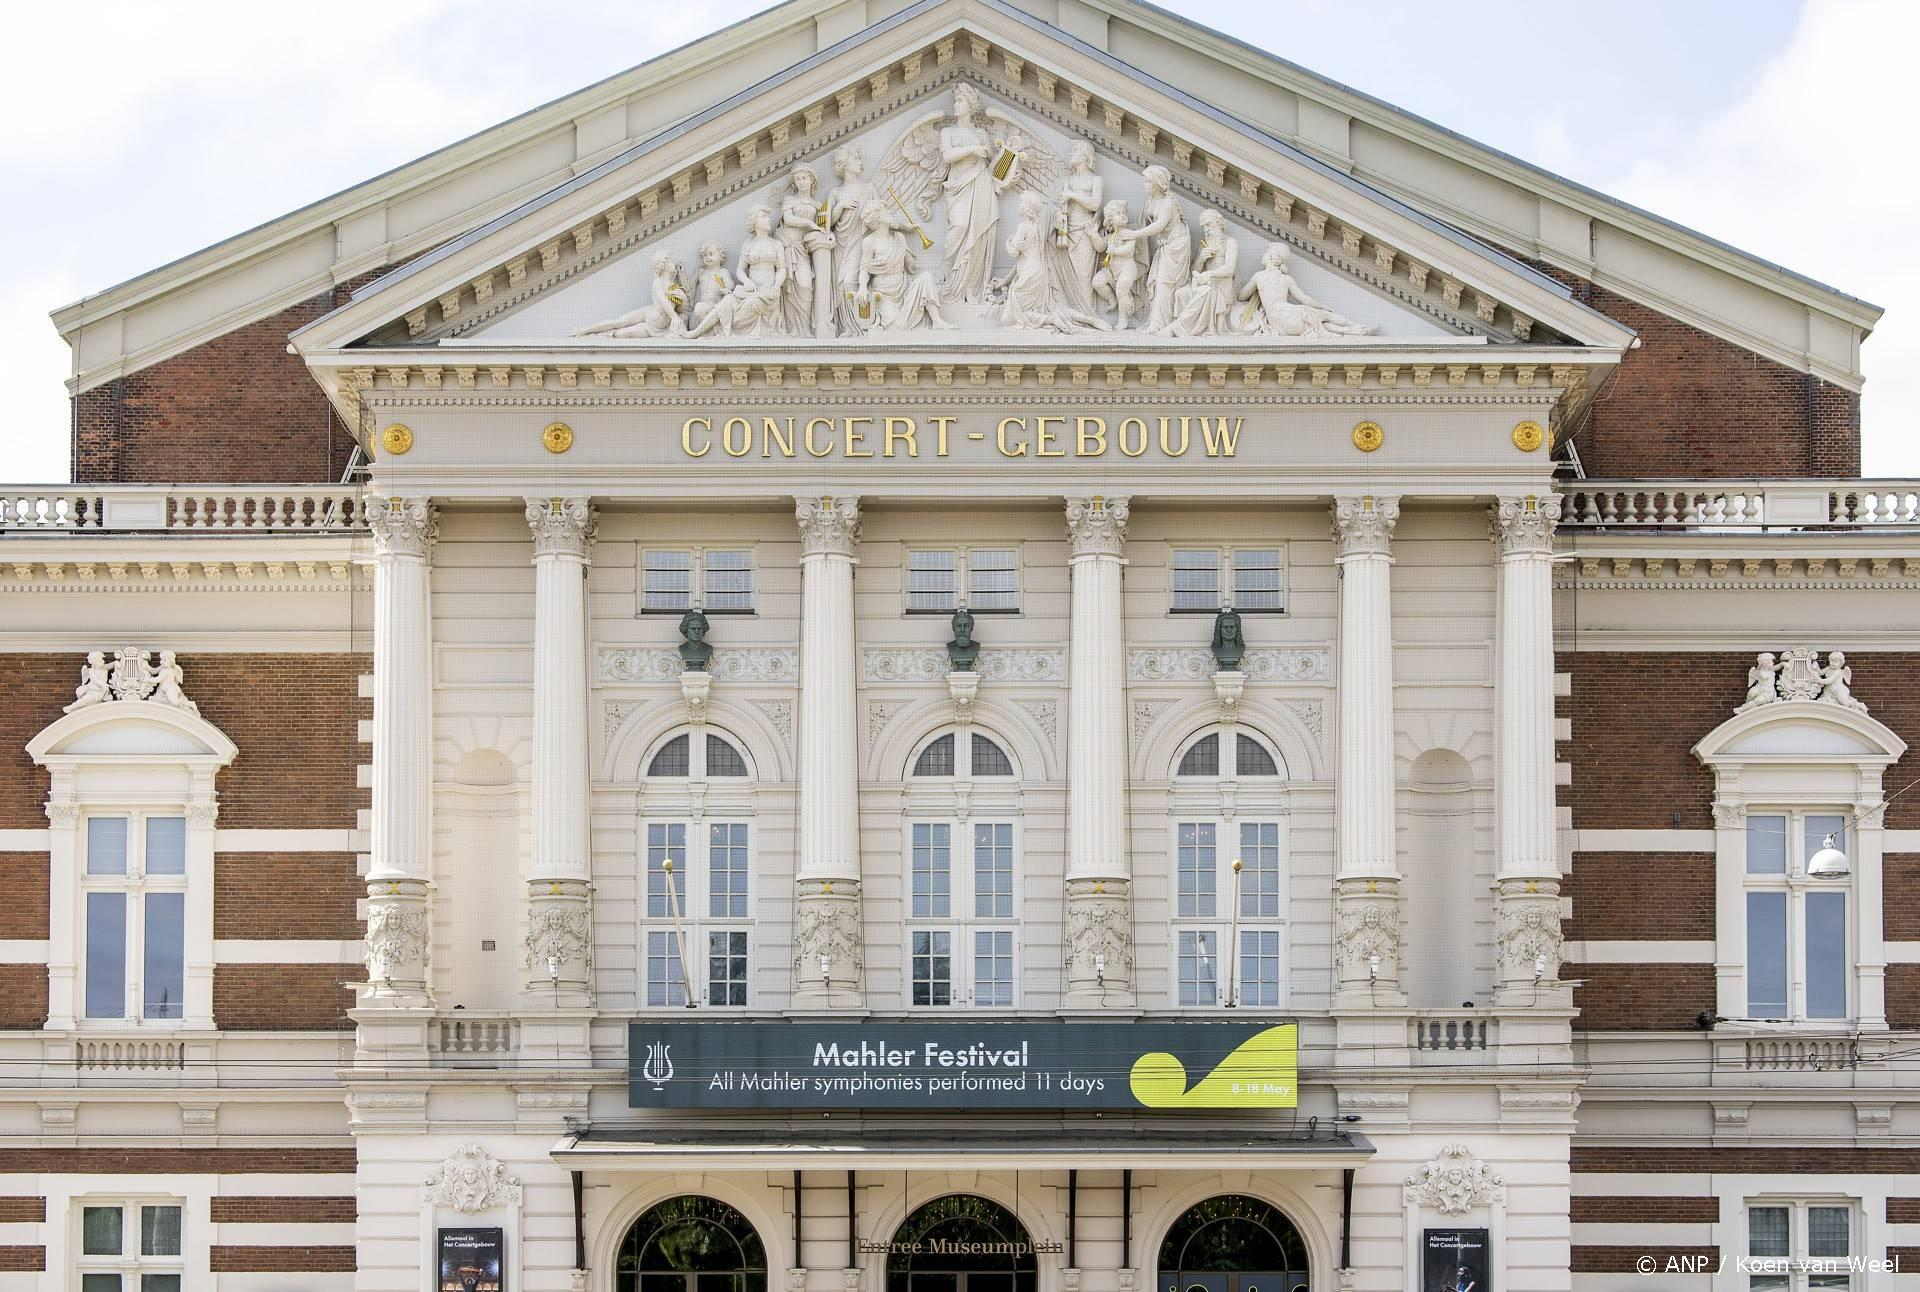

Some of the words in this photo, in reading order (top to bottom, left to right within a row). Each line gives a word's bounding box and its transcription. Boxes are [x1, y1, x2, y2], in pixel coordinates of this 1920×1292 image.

[681, 416, 1246, 459] CONCERT-GEBOUW
[813, 1041, 915, 1067] Mahler
[925, 1041, 1028, 1067] Festival
[709, 1071, 733, 1091] All
[740, 1071, 809, 1091] Mahler
[814, 1071, 923, 1096] symphonies
[929, 1071, 1026, 1096] performed
[1036, 1072, 1050, 1091] 11
[1060, 1071, 1105, 1096] days
[1263, 1083, 1290, 1097] May
[454, 1241, 496, 1249] Concertgebouw
[856, 1238, 922, 1254] Entree
[928, 1237, 1065, 1259] Museumplein
